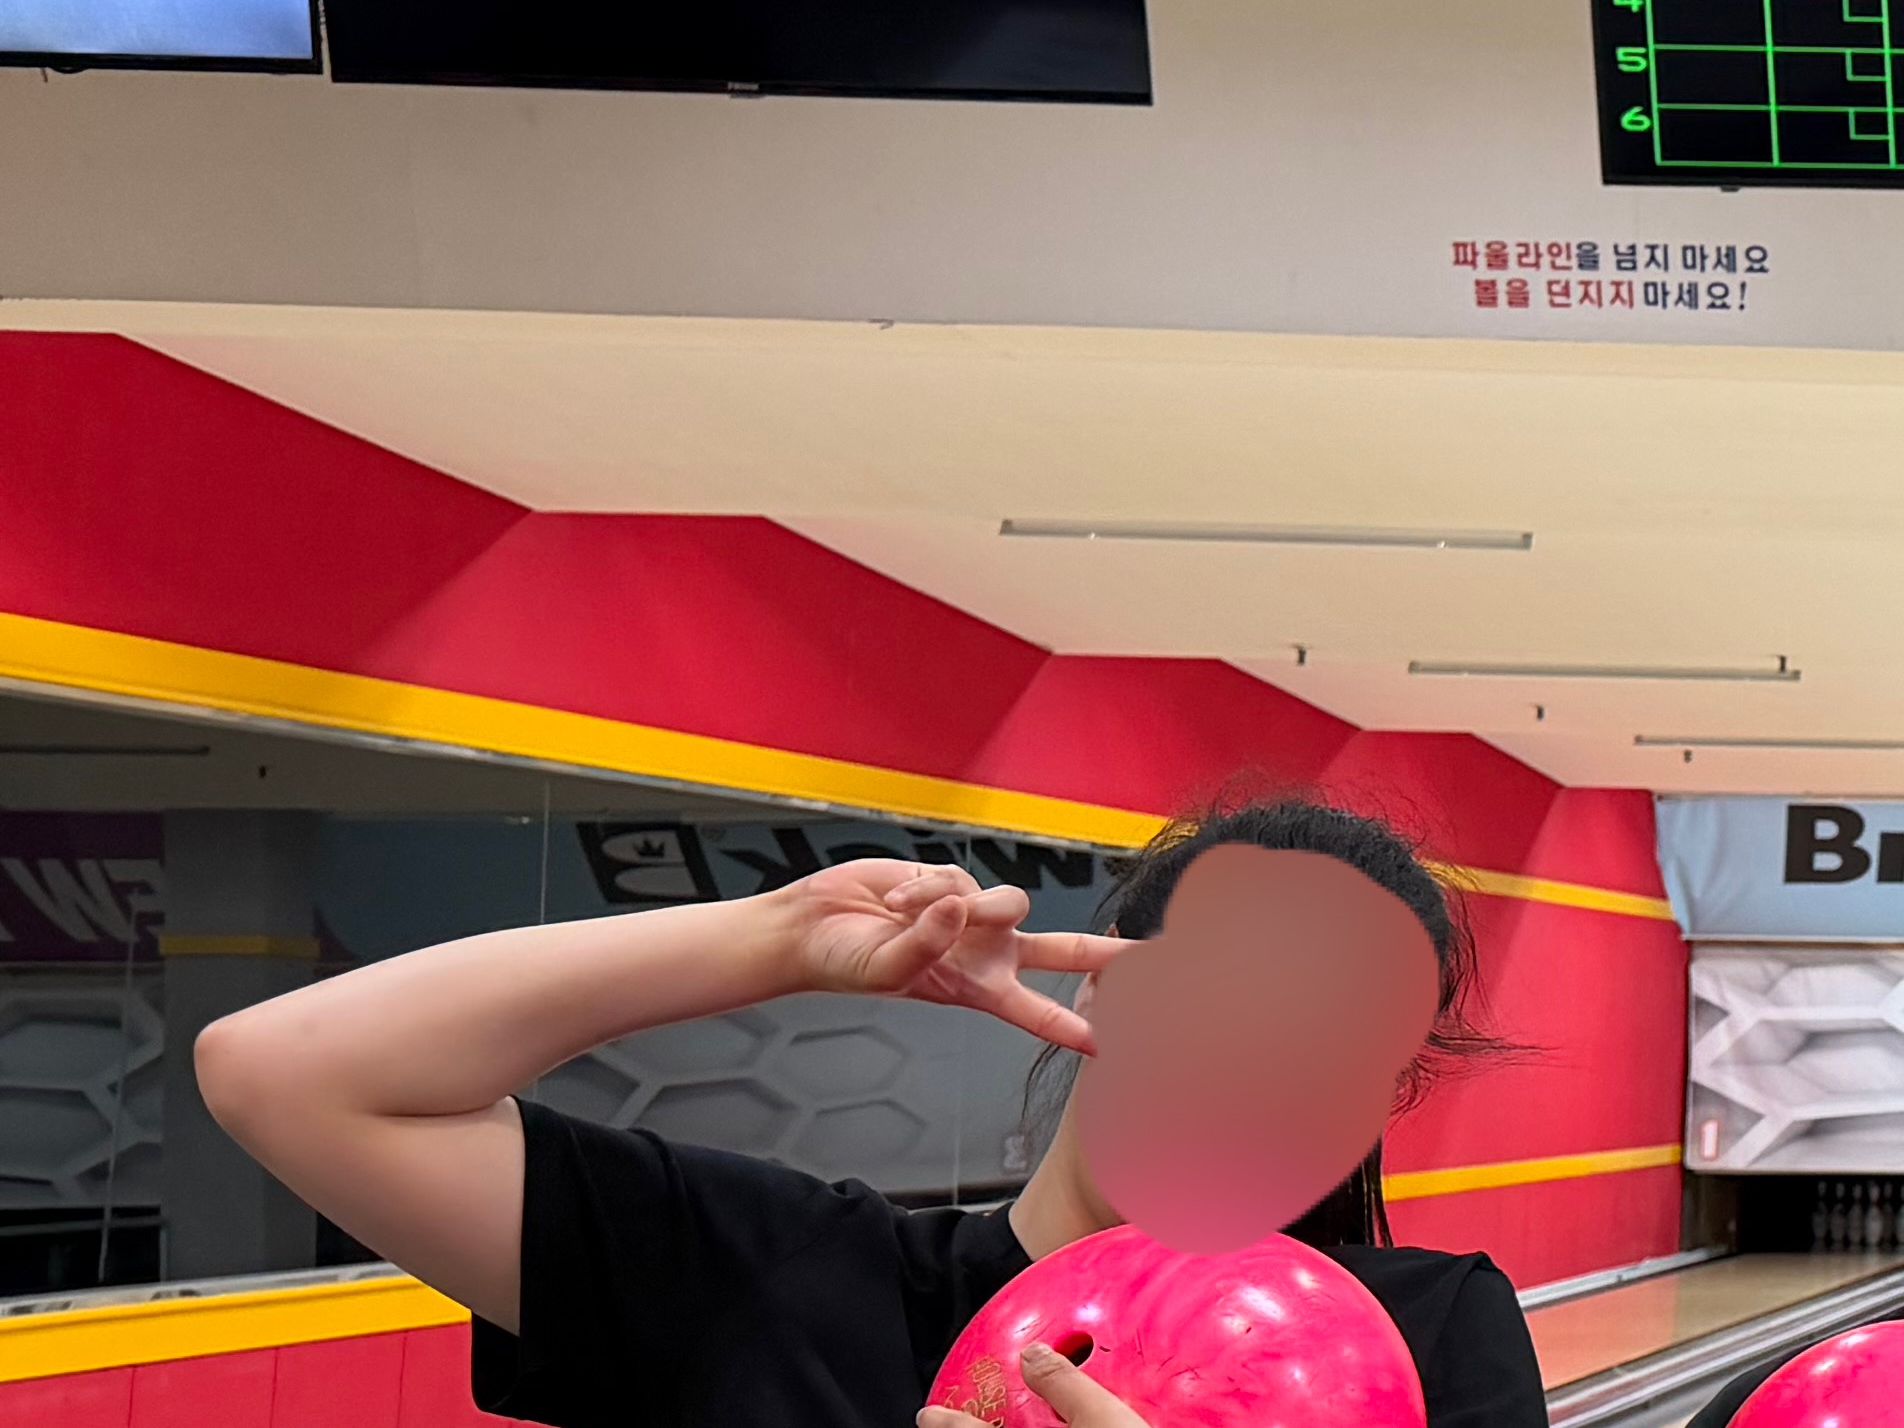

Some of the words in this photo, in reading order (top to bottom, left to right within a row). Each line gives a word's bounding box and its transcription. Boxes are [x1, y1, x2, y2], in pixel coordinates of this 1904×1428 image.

[1615, 46, 1648, 73] 5
[1620, 106, 1652, 132] 6
[1451, 240, 1602, 272] 파울라인을
[1613, 242, 1671, 273] 넘지
[1681, 242, 1771, 275] 마세요
[1473, 277, 1532, 310] 볼을
[1546, 279, 1636, 310] 던지지
[1643, 280, 1748, 312] 마세요!
[1700, 1119, 1720, 1161] 1
